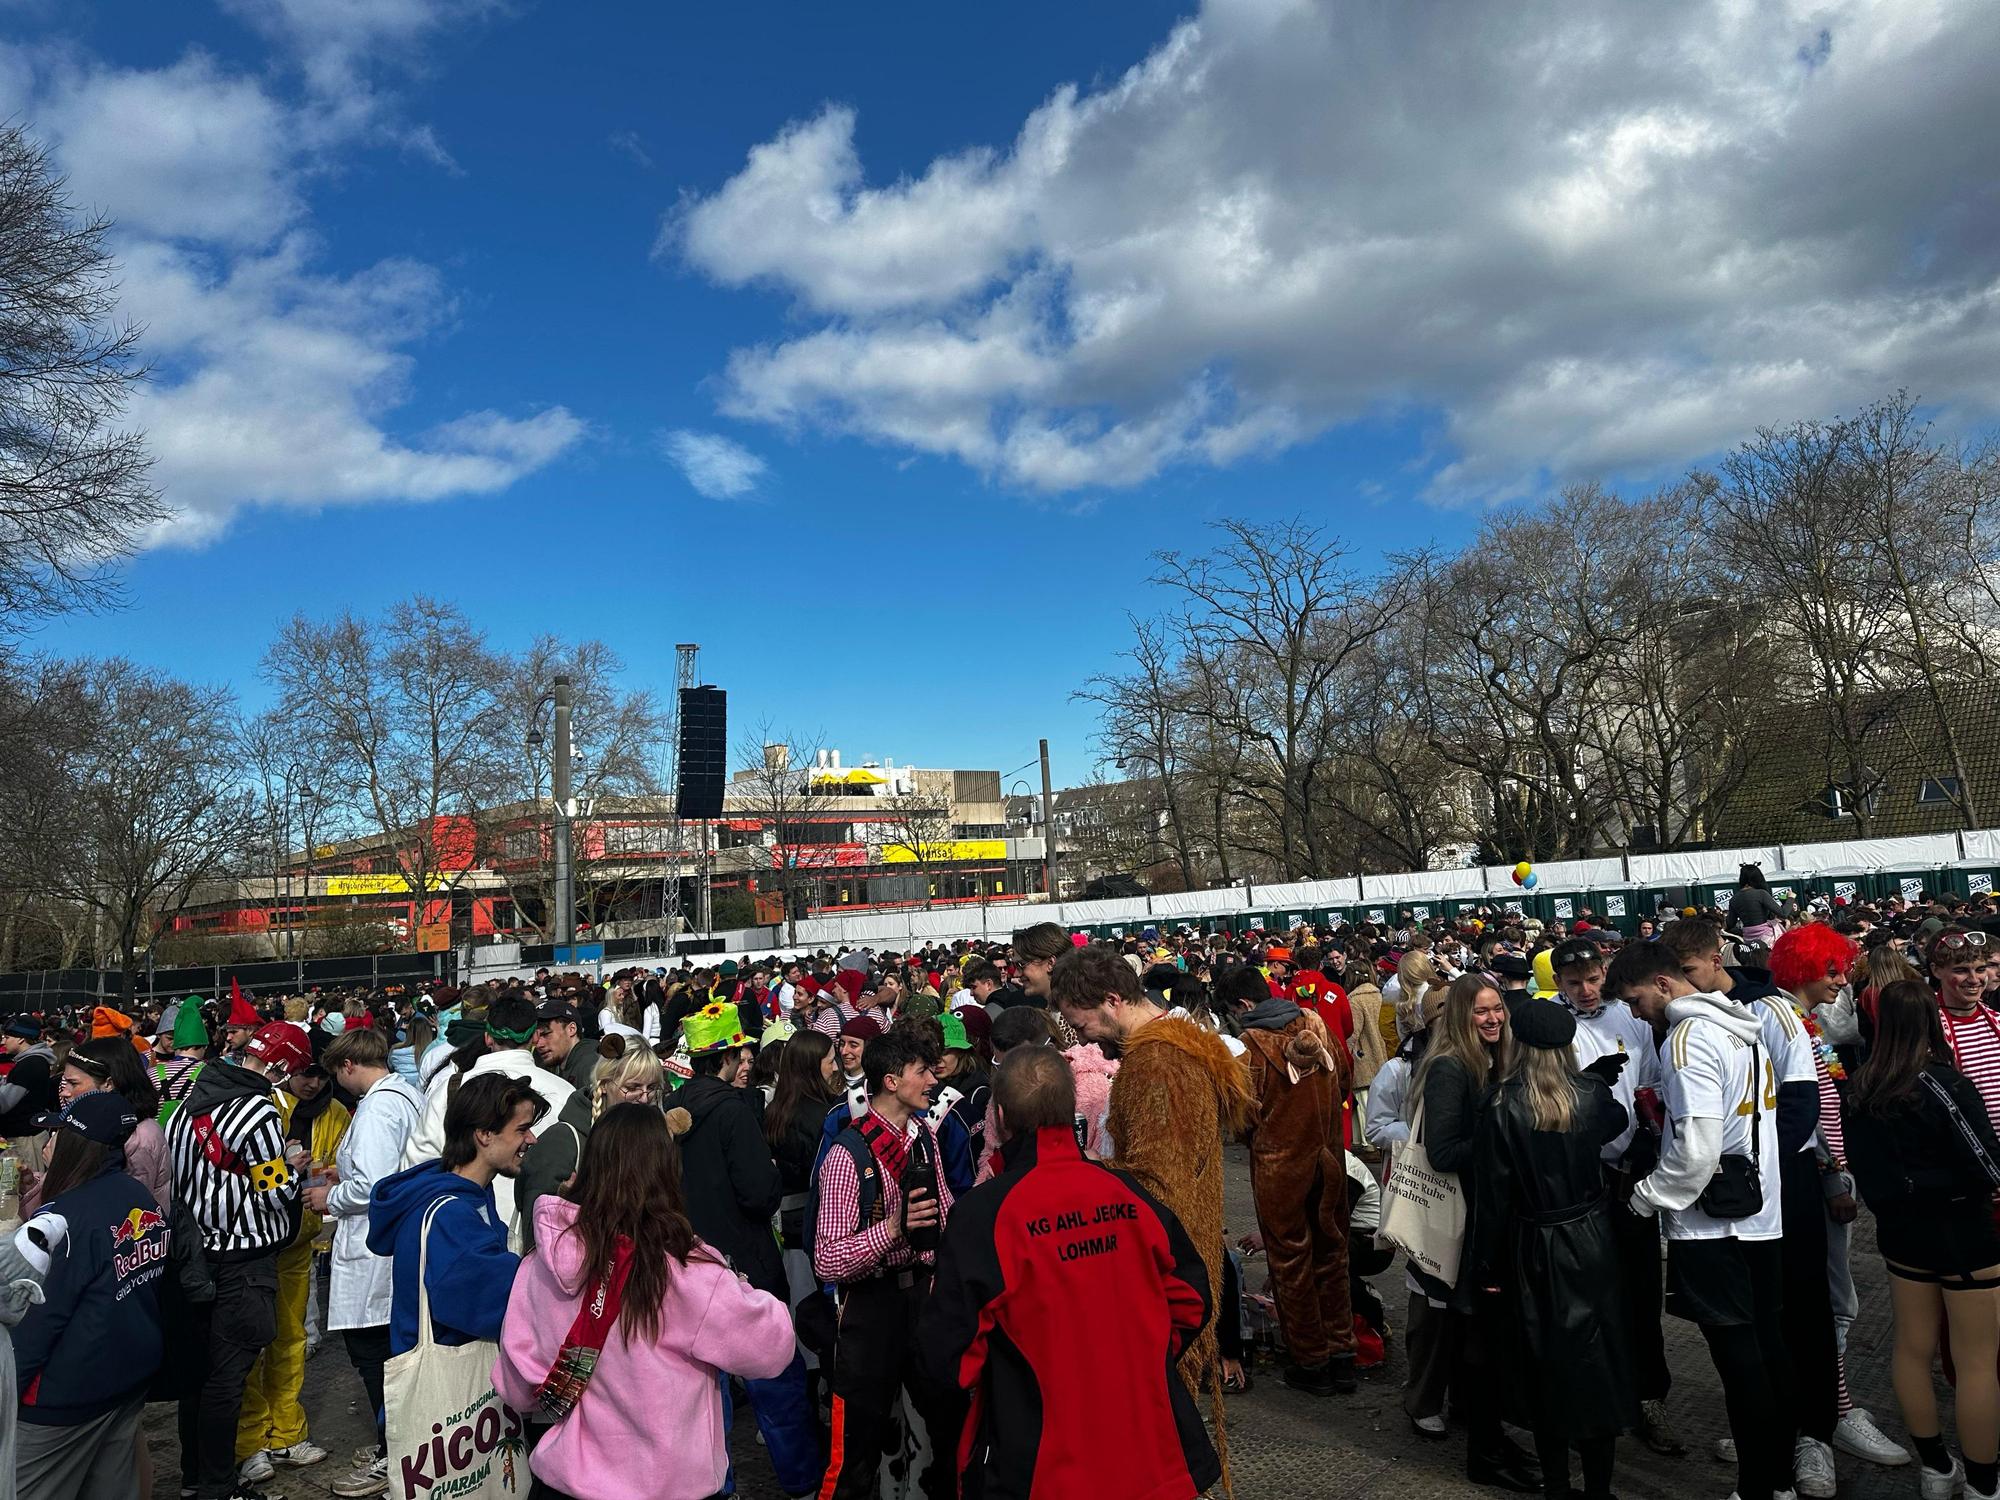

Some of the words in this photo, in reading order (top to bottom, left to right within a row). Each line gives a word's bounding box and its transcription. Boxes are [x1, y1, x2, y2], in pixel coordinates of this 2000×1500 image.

[1421, 1183, 1446, 1201] Ruhe
[1026, 1216, 1051, 1238] KG
[1056, 1211, 1088, 1232] AHL
[1092, 1203, 1138, 1224] JECKE
[1057, 1234, 1119, 1261] LOHMAR
[446, 1412, 462, 1427] DAS
